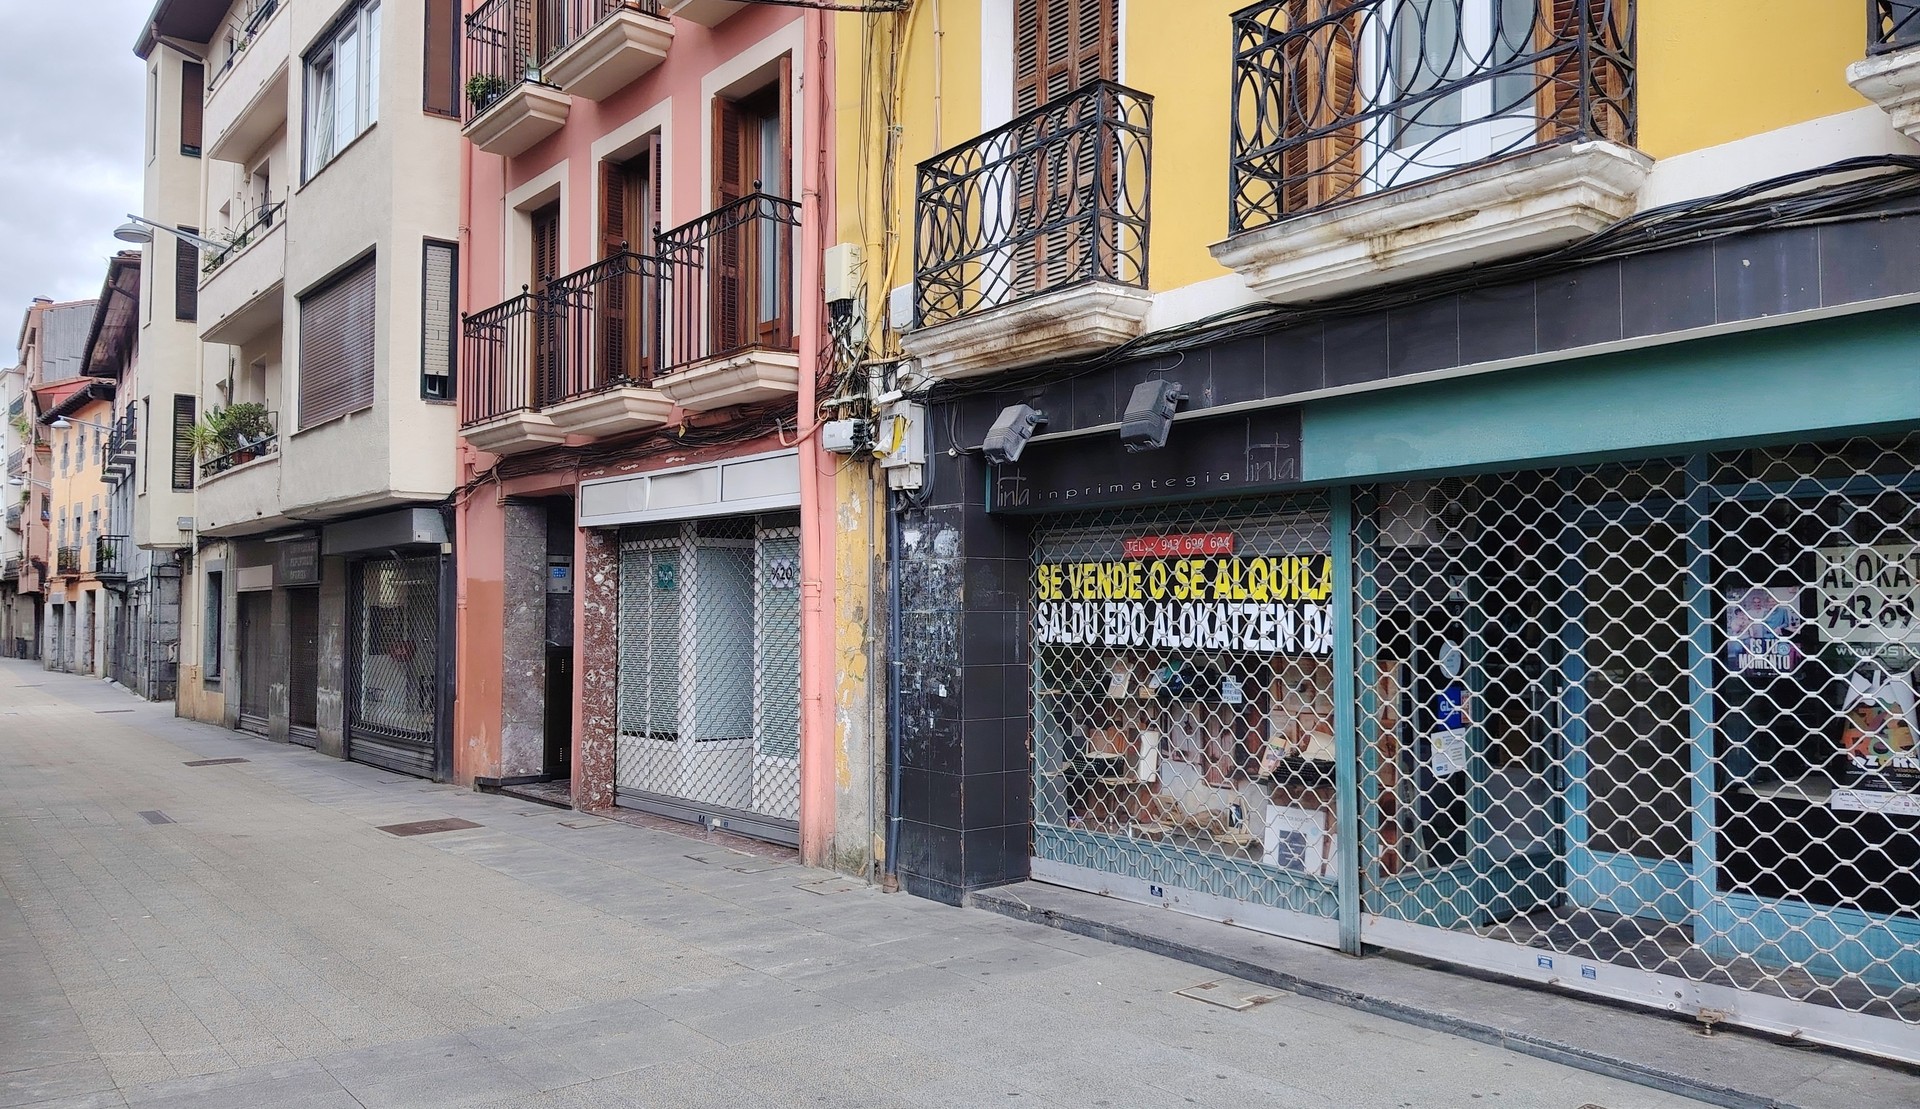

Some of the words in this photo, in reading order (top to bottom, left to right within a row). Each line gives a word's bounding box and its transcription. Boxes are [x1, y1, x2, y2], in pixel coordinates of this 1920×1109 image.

[1038, 471, 1230, 499] inprimategia
[1161, 539, 1179, 551] 943
[1038, 564, 1063, 600] SE
[1069, 562, 1143, 600] VENDE
[1150, 560, 1167, 600] O
[1174, 559, 1206, 600] SE
[1213, 557, 1332, 603] ALQUILA
[1823, 595, 1872, 628] 943
[1037, 602, 1098, 644] SALDU
[1105, 602, 1146, 646] EDO
[1152, 602, 1294, 653] ALOKATZEN
[1304, 603, 1333, 654] DA
[1738, 653, 1790, 670] MOMENTO
